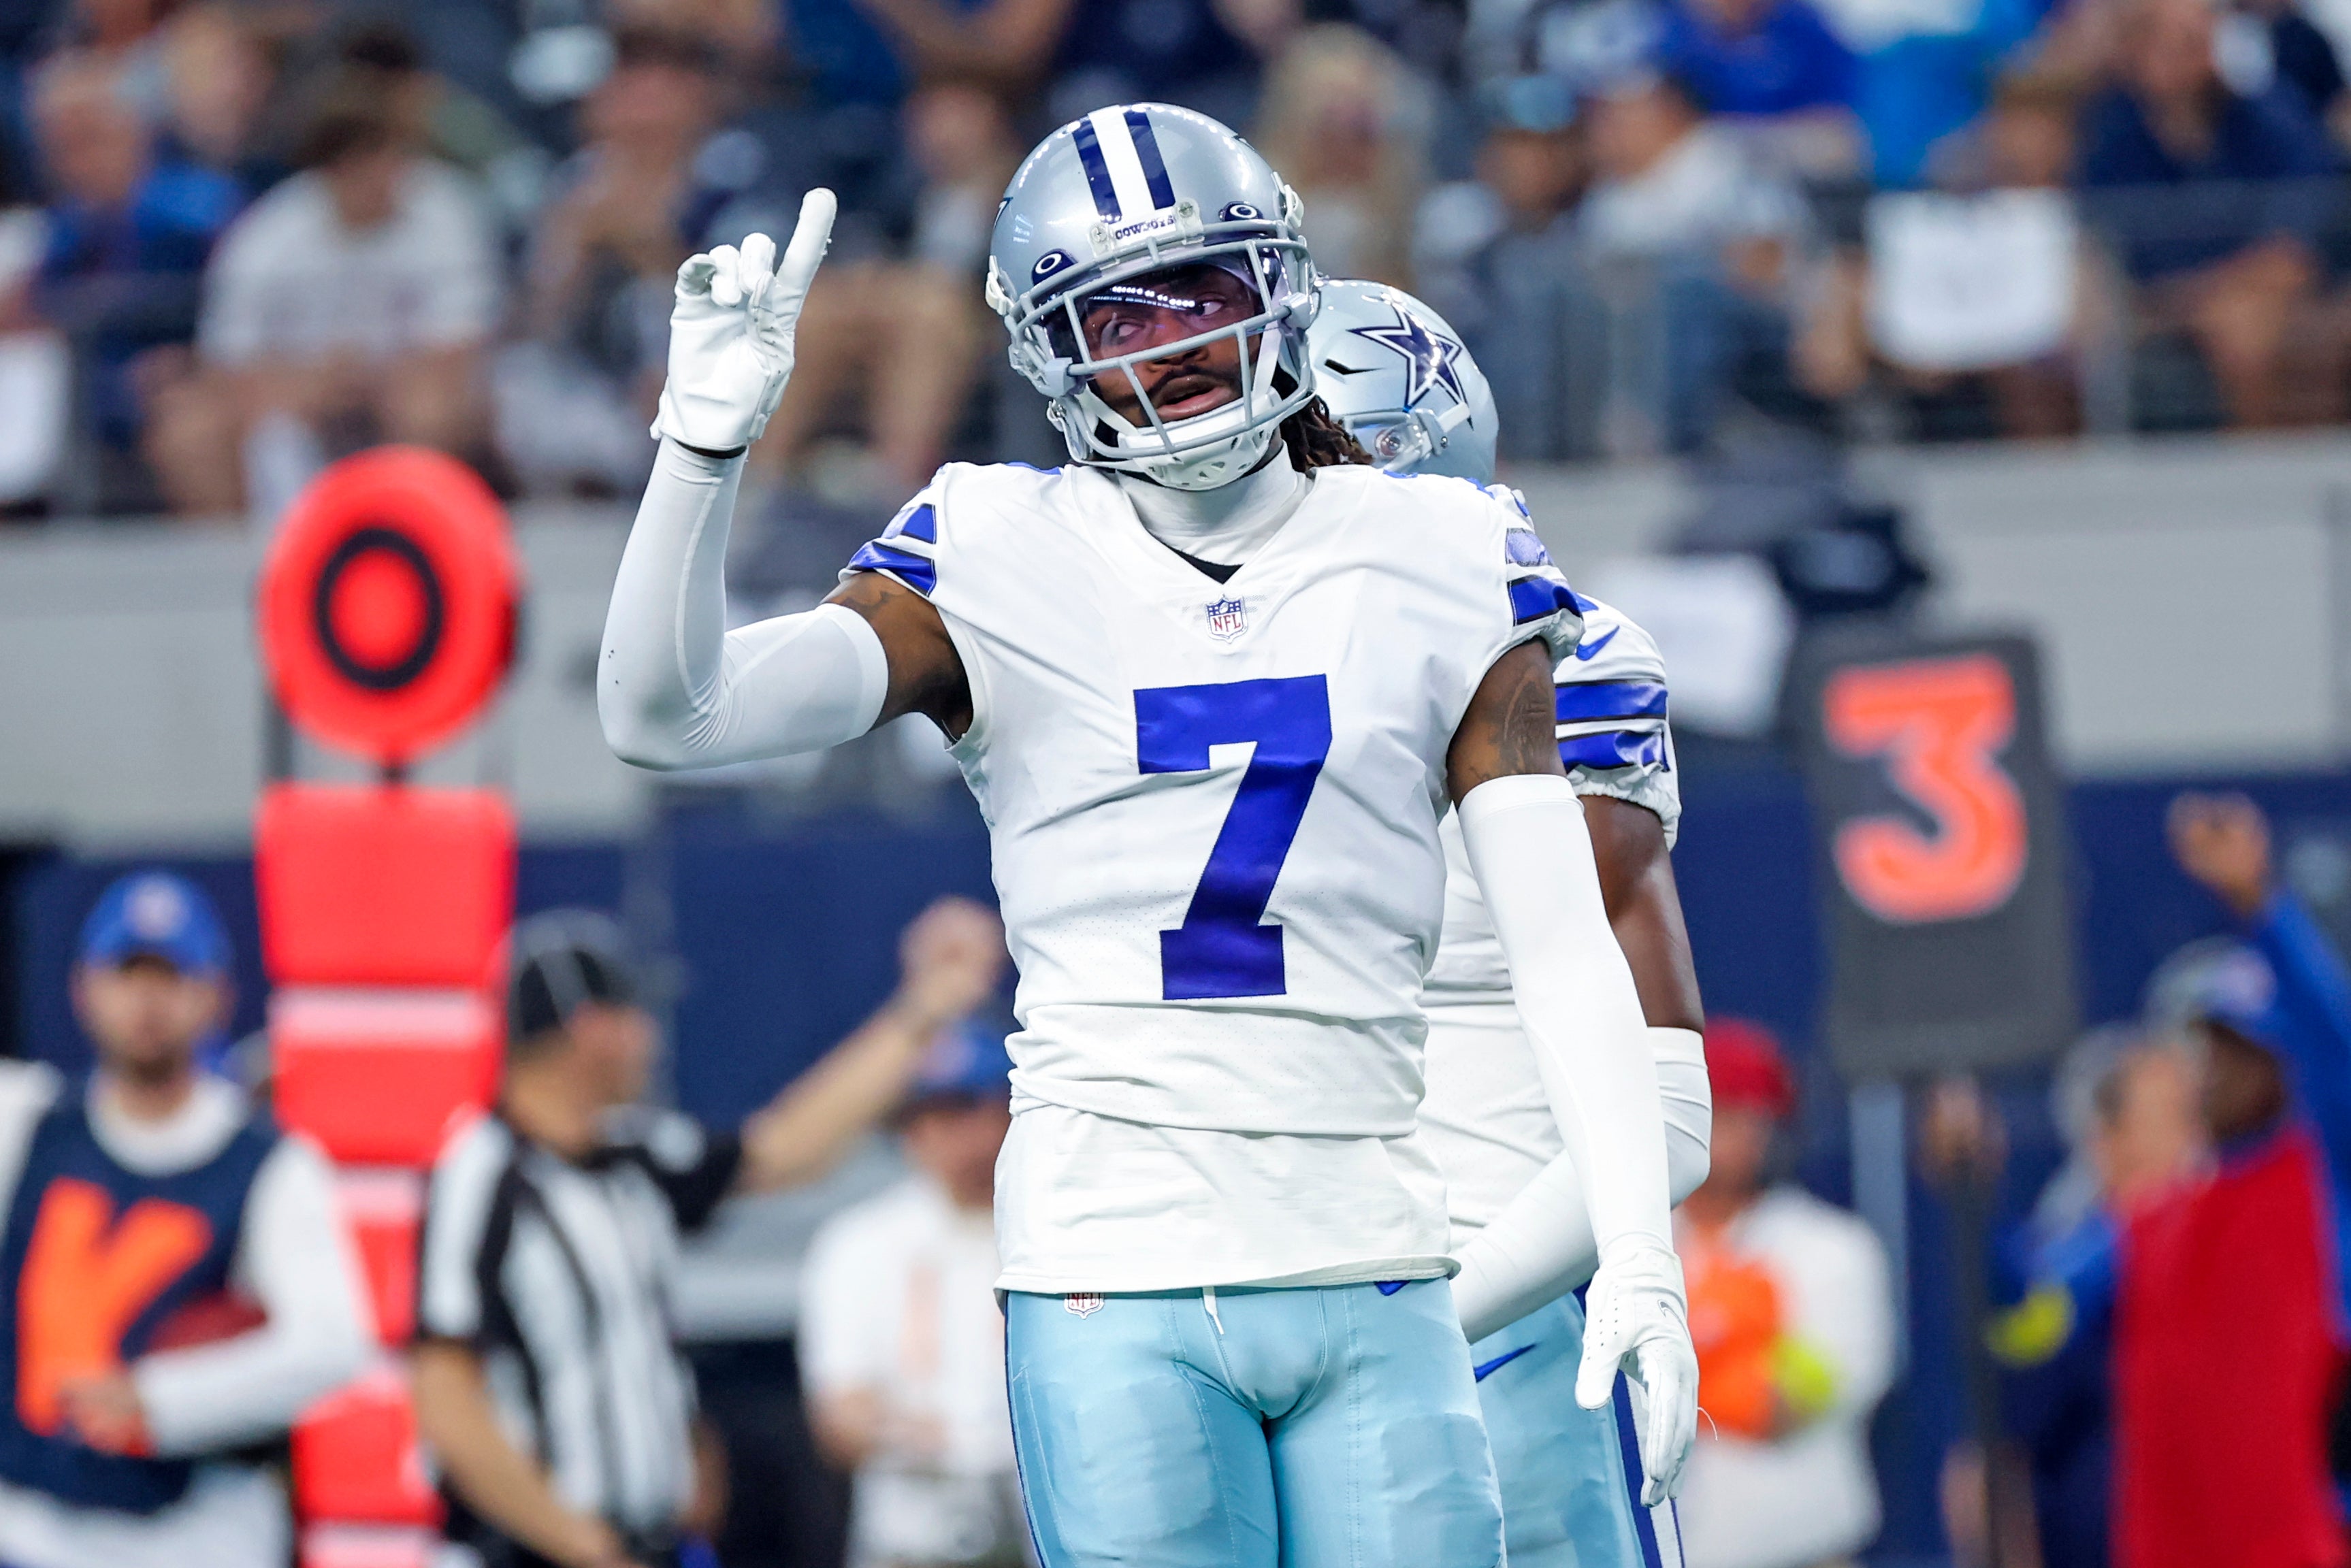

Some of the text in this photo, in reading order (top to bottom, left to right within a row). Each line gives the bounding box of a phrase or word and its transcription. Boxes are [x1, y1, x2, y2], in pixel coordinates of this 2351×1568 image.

[1212, 614, 1242, 632] NFL
[1133, 673, 1332, 1000] 7
[1822, 653, 2028, 924] 3
